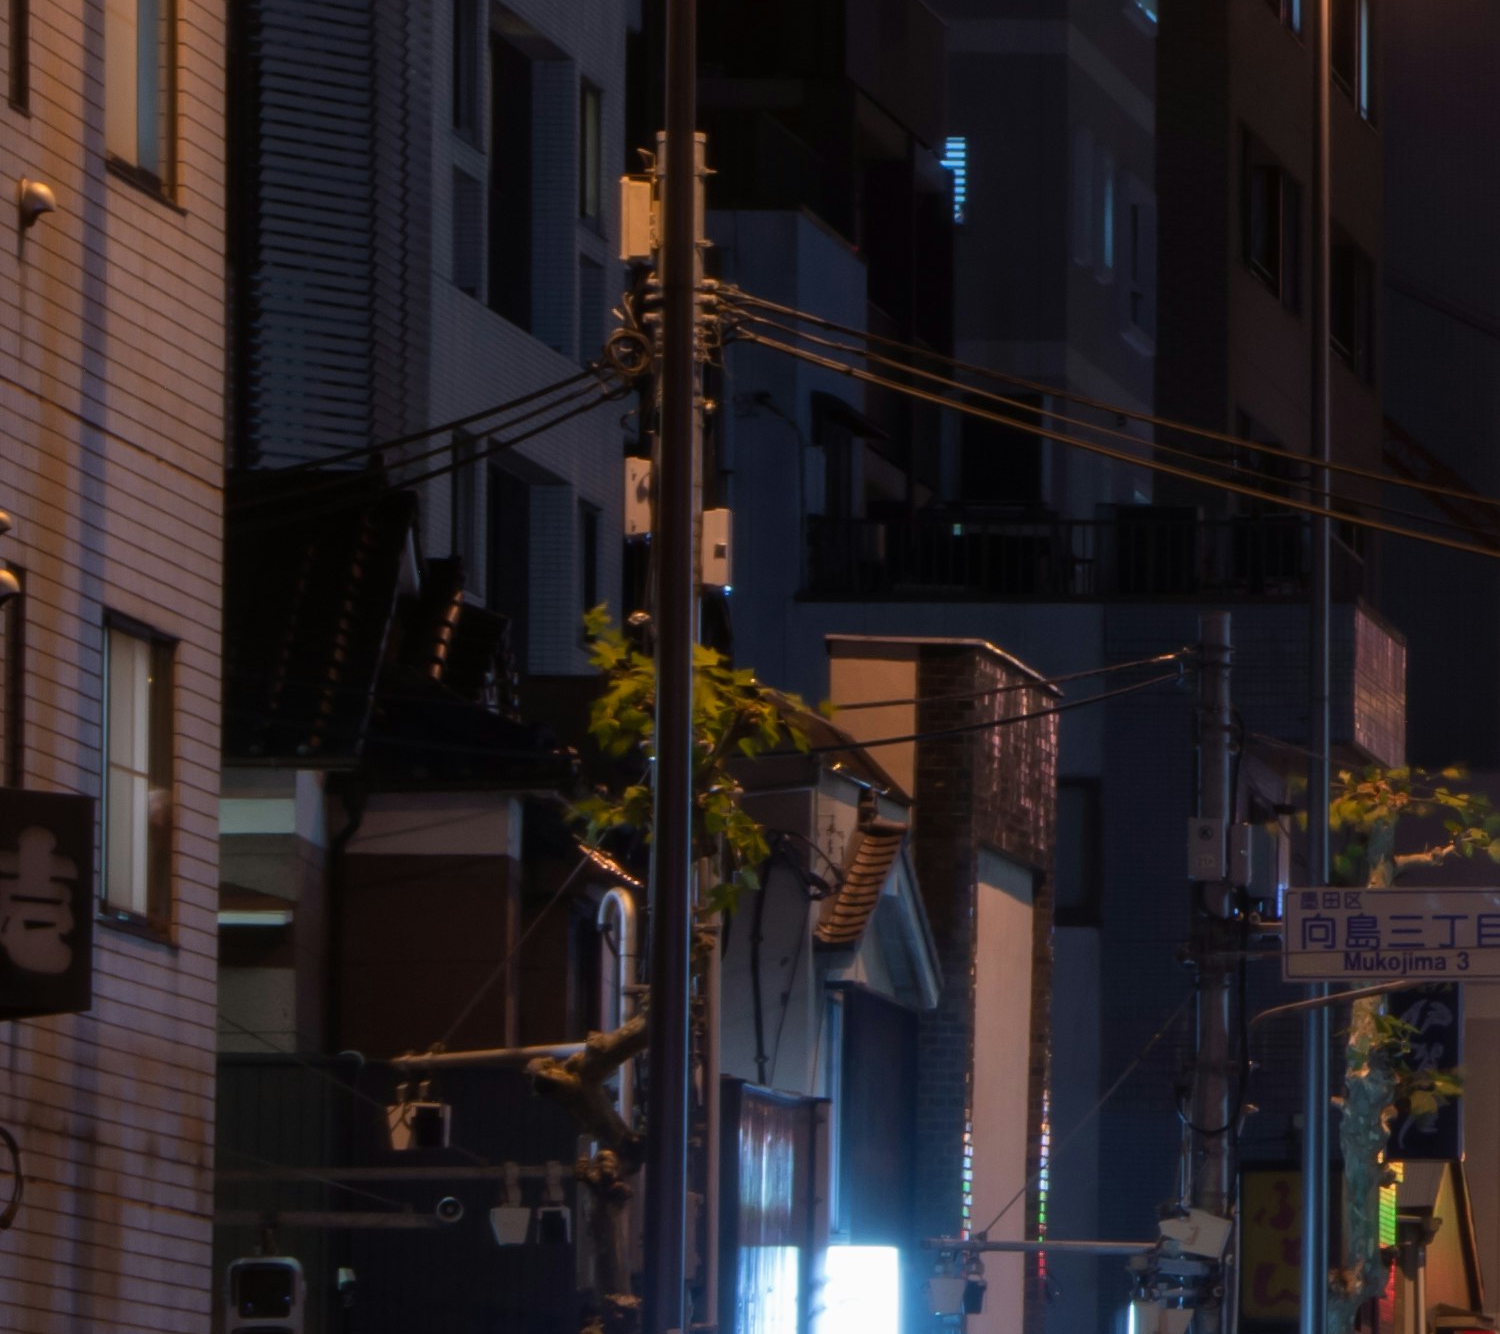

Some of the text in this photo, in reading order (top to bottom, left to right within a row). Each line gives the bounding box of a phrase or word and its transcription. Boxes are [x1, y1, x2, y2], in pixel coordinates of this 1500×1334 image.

[1301, 892, 1362, 910] 墨田区
[1344, 952, 1470, 975] Mukojima 3
